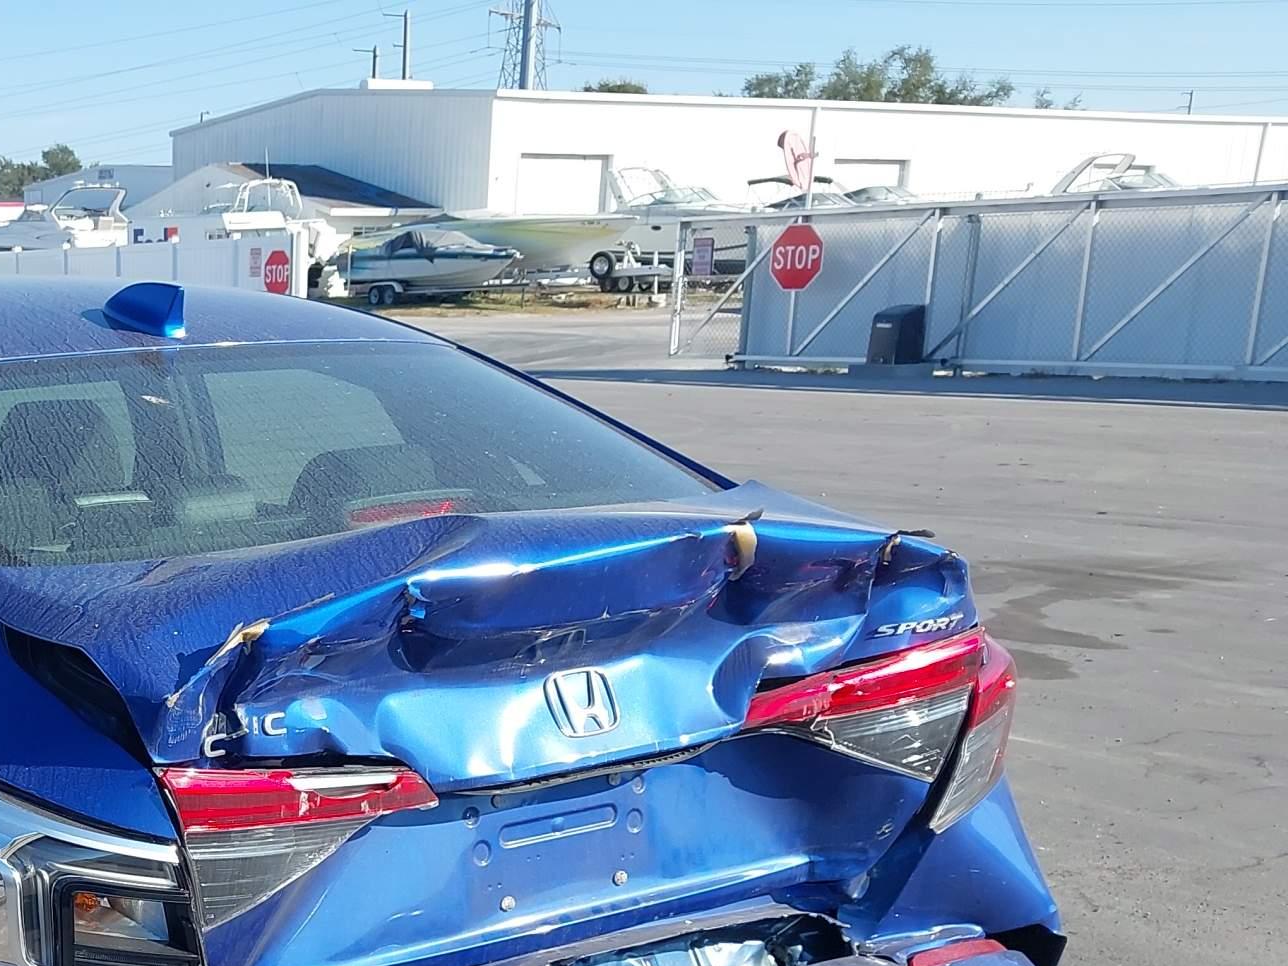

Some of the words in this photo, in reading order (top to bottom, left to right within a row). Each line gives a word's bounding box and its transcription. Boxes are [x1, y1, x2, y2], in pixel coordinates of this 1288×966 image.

[774, 244, 820, 270] STOP
[265, 264, 289, 283] STOP
[874, 612, 964, 637] SPORT
